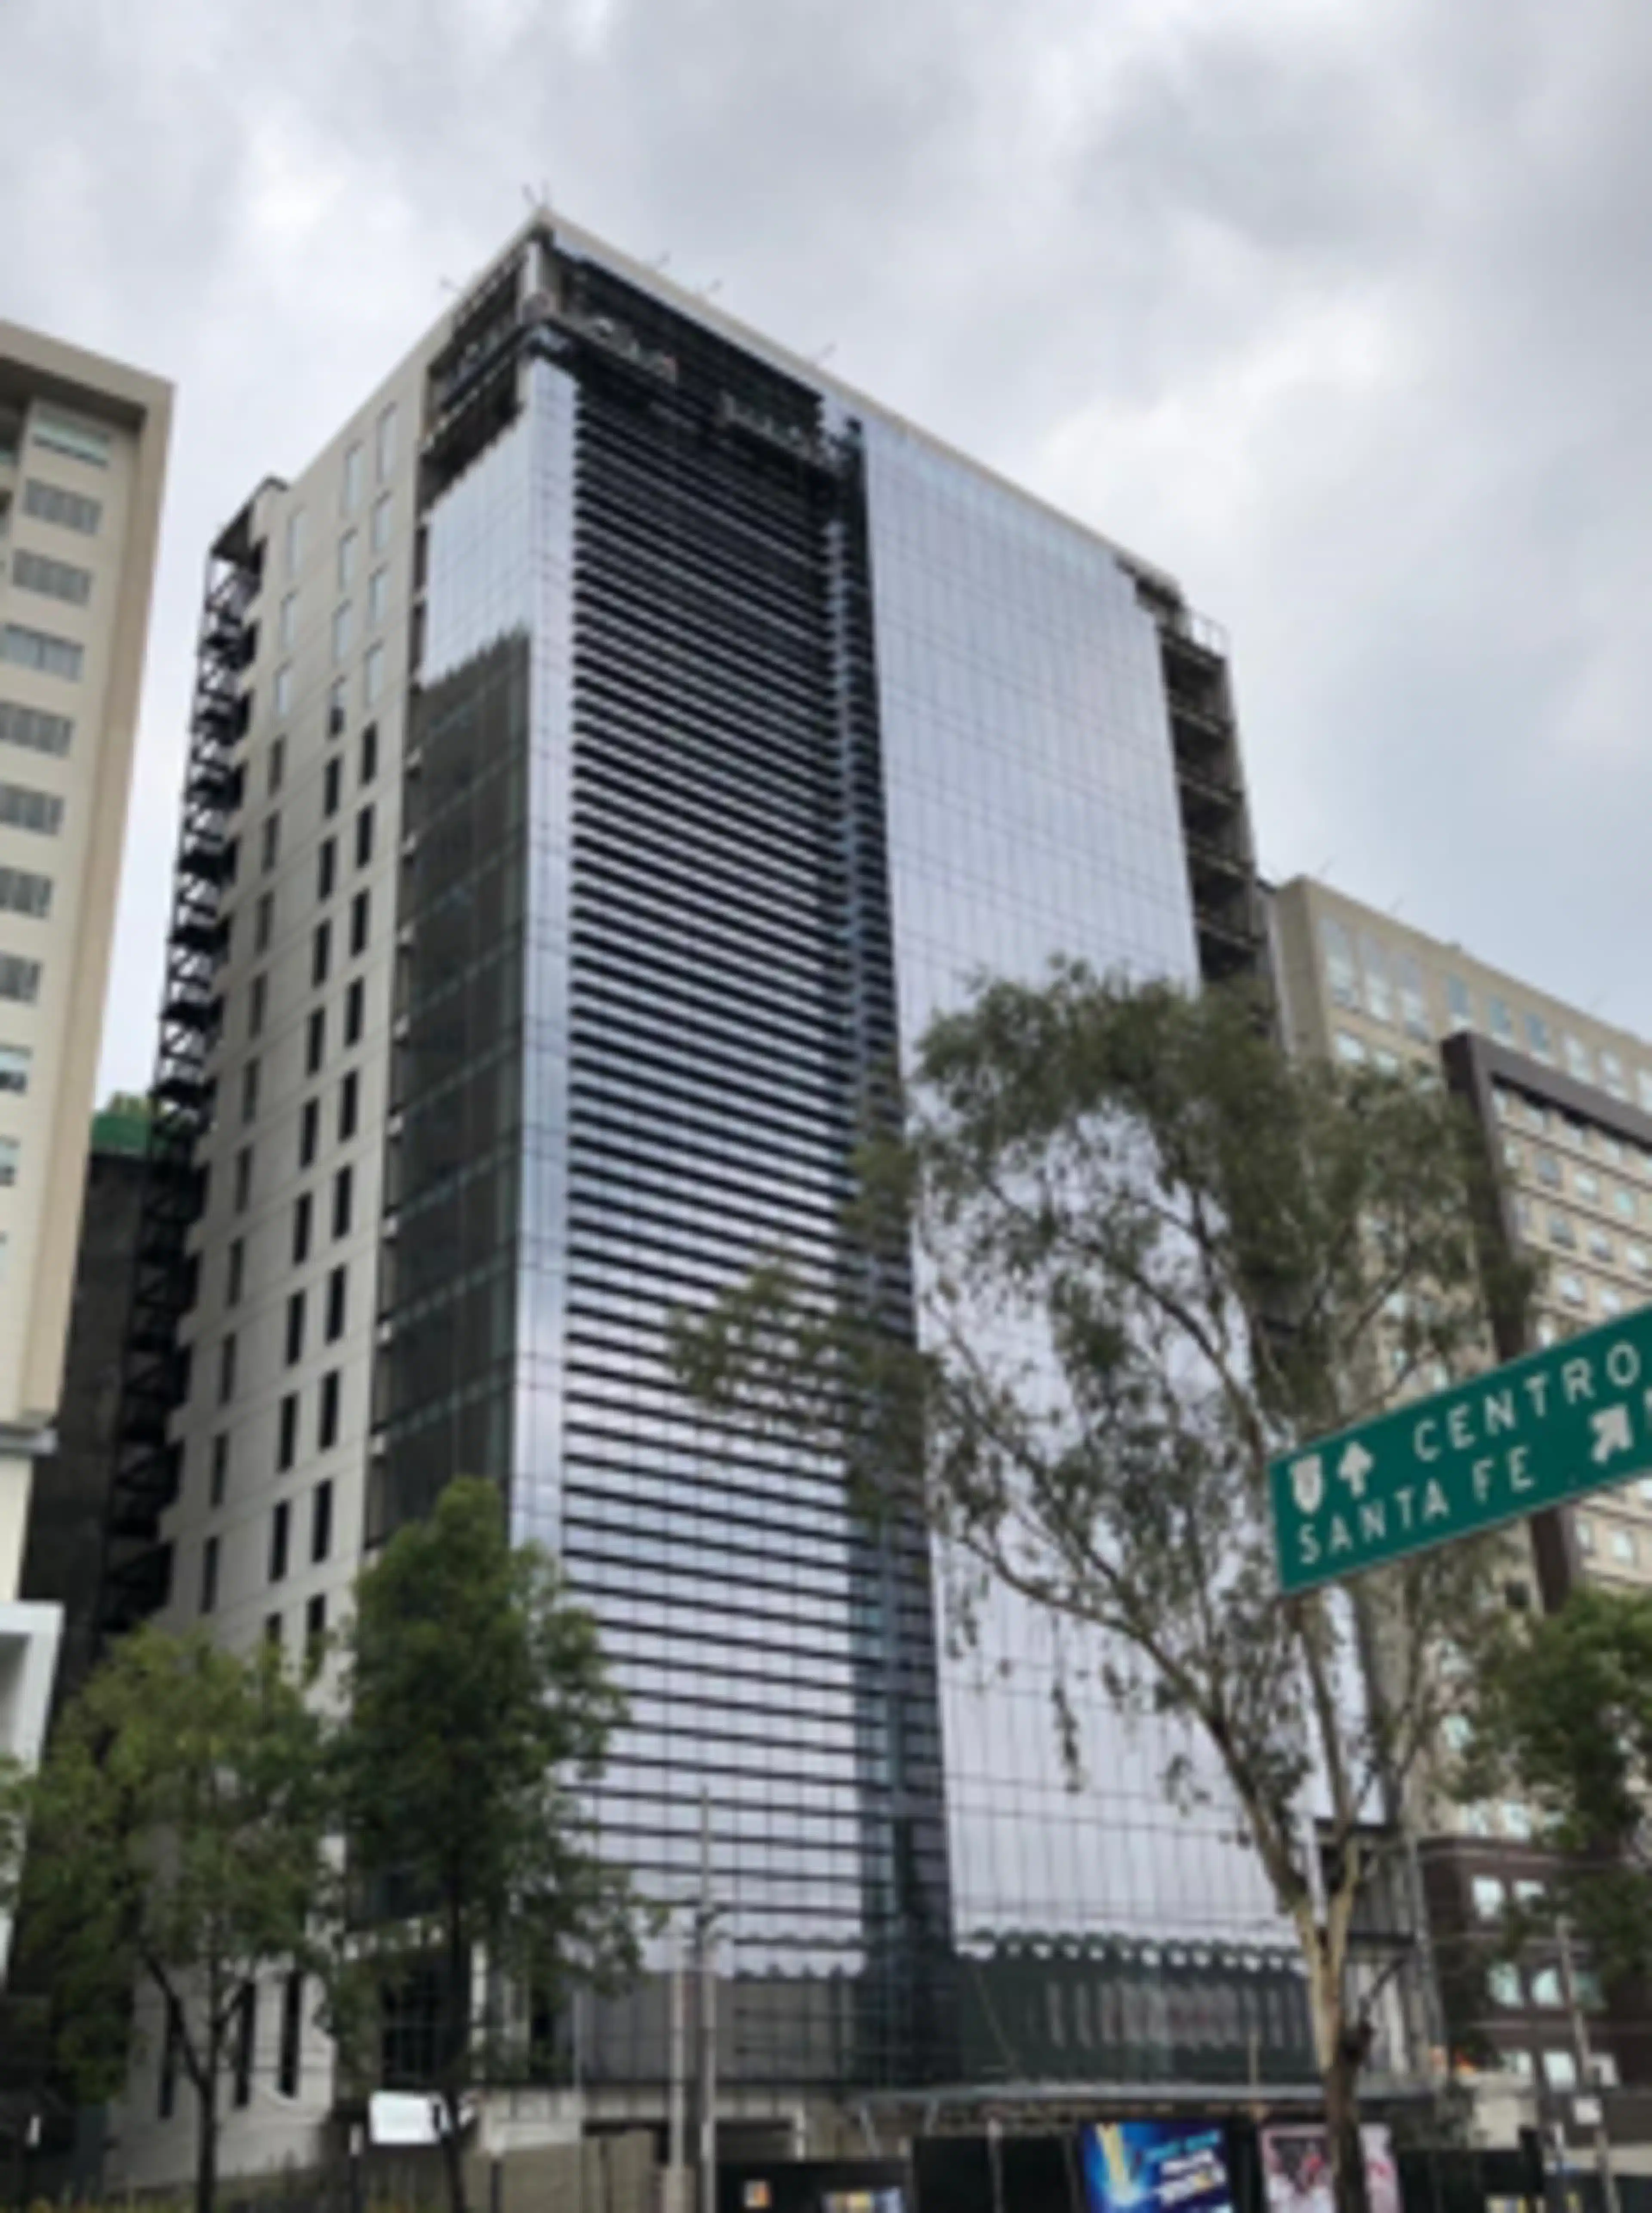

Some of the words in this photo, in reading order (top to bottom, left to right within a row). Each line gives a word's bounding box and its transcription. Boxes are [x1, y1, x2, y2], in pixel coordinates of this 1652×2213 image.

[1414, 1342, 1640, 1461] CENTRO
[1298, 1478, 1449, 1564] SANTA
[1472, 1446, 1535, 1503] FE
